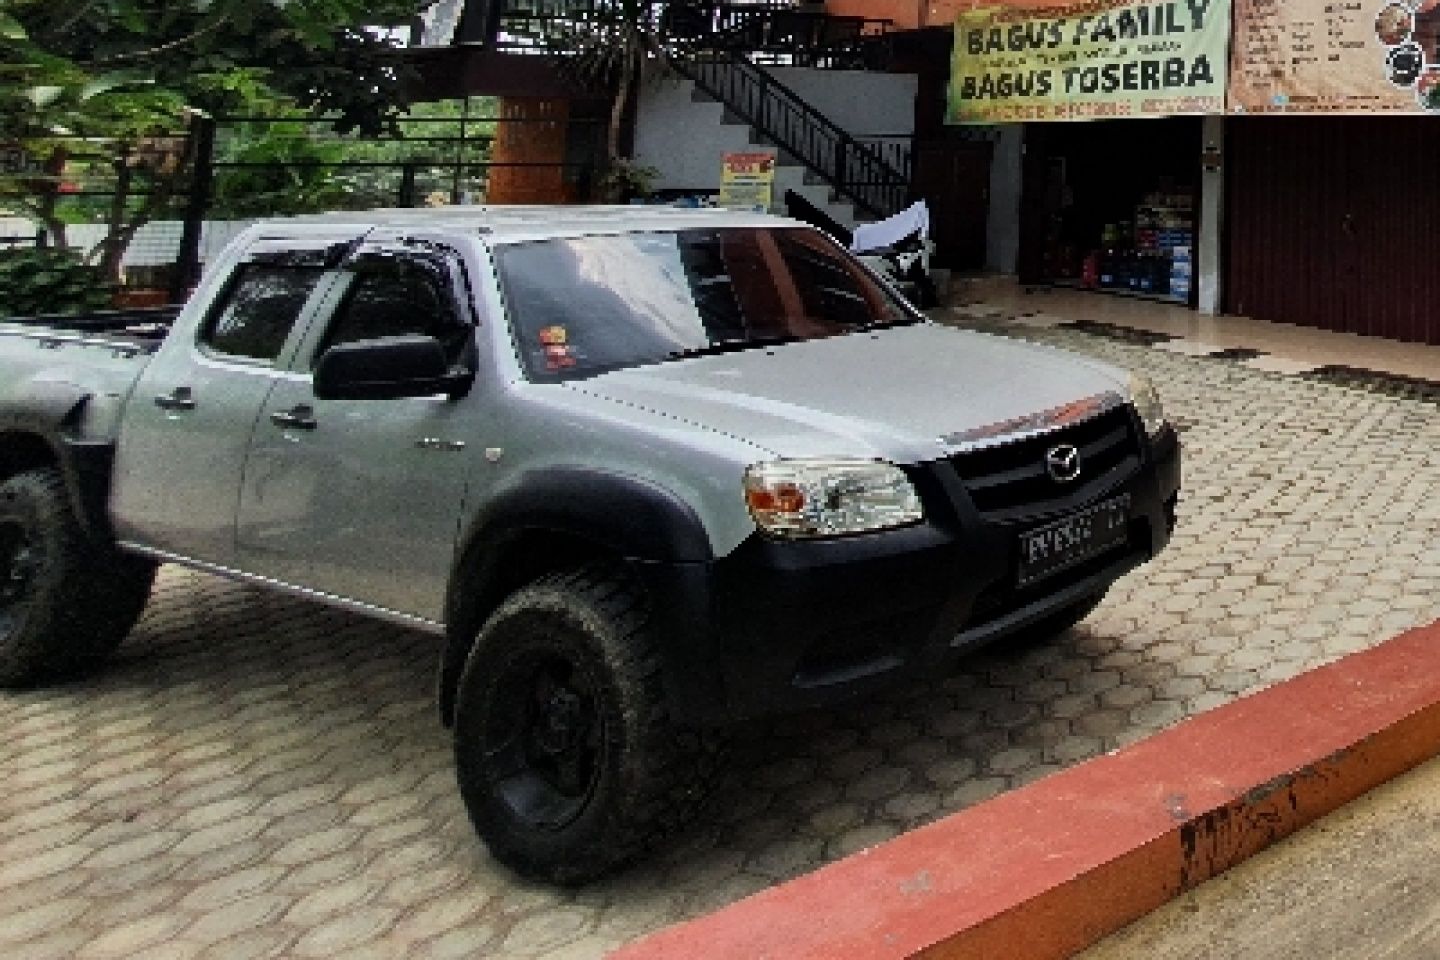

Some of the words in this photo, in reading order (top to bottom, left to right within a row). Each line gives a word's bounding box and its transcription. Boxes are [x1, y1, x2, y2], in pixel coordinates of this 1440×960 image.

[967, 18, 1066, 55] BAGUS
[960, 70, 1053, 100] BAGUS
[1062, 53, 1214, 94] TOSERBA
